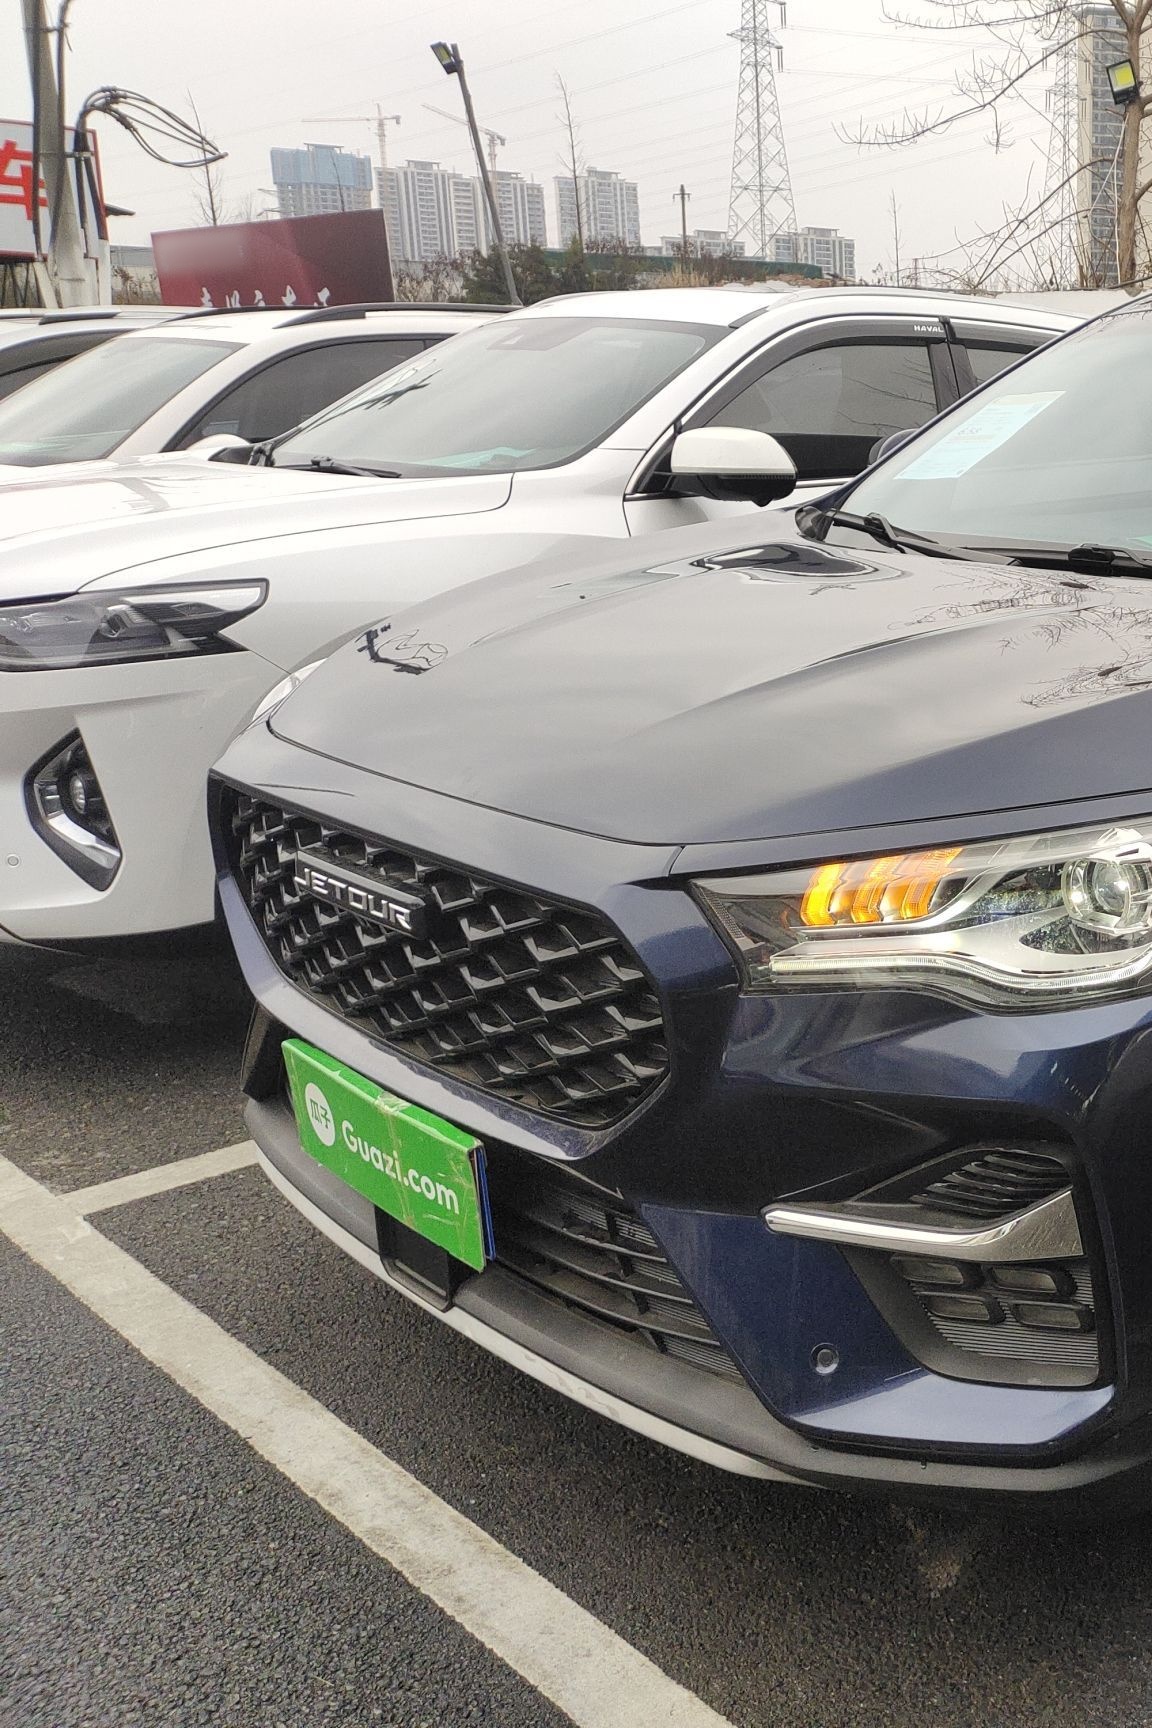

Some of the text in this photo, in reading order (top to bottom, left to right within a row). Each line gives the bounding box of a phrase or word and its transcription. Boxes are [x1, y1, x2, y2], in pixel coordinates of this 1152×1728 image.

[294, 867, 411, 930] JETOUR
[309, 1098, 331, 1129] 瓜子
[341, 1119, 460, 1215] Guazi.com
